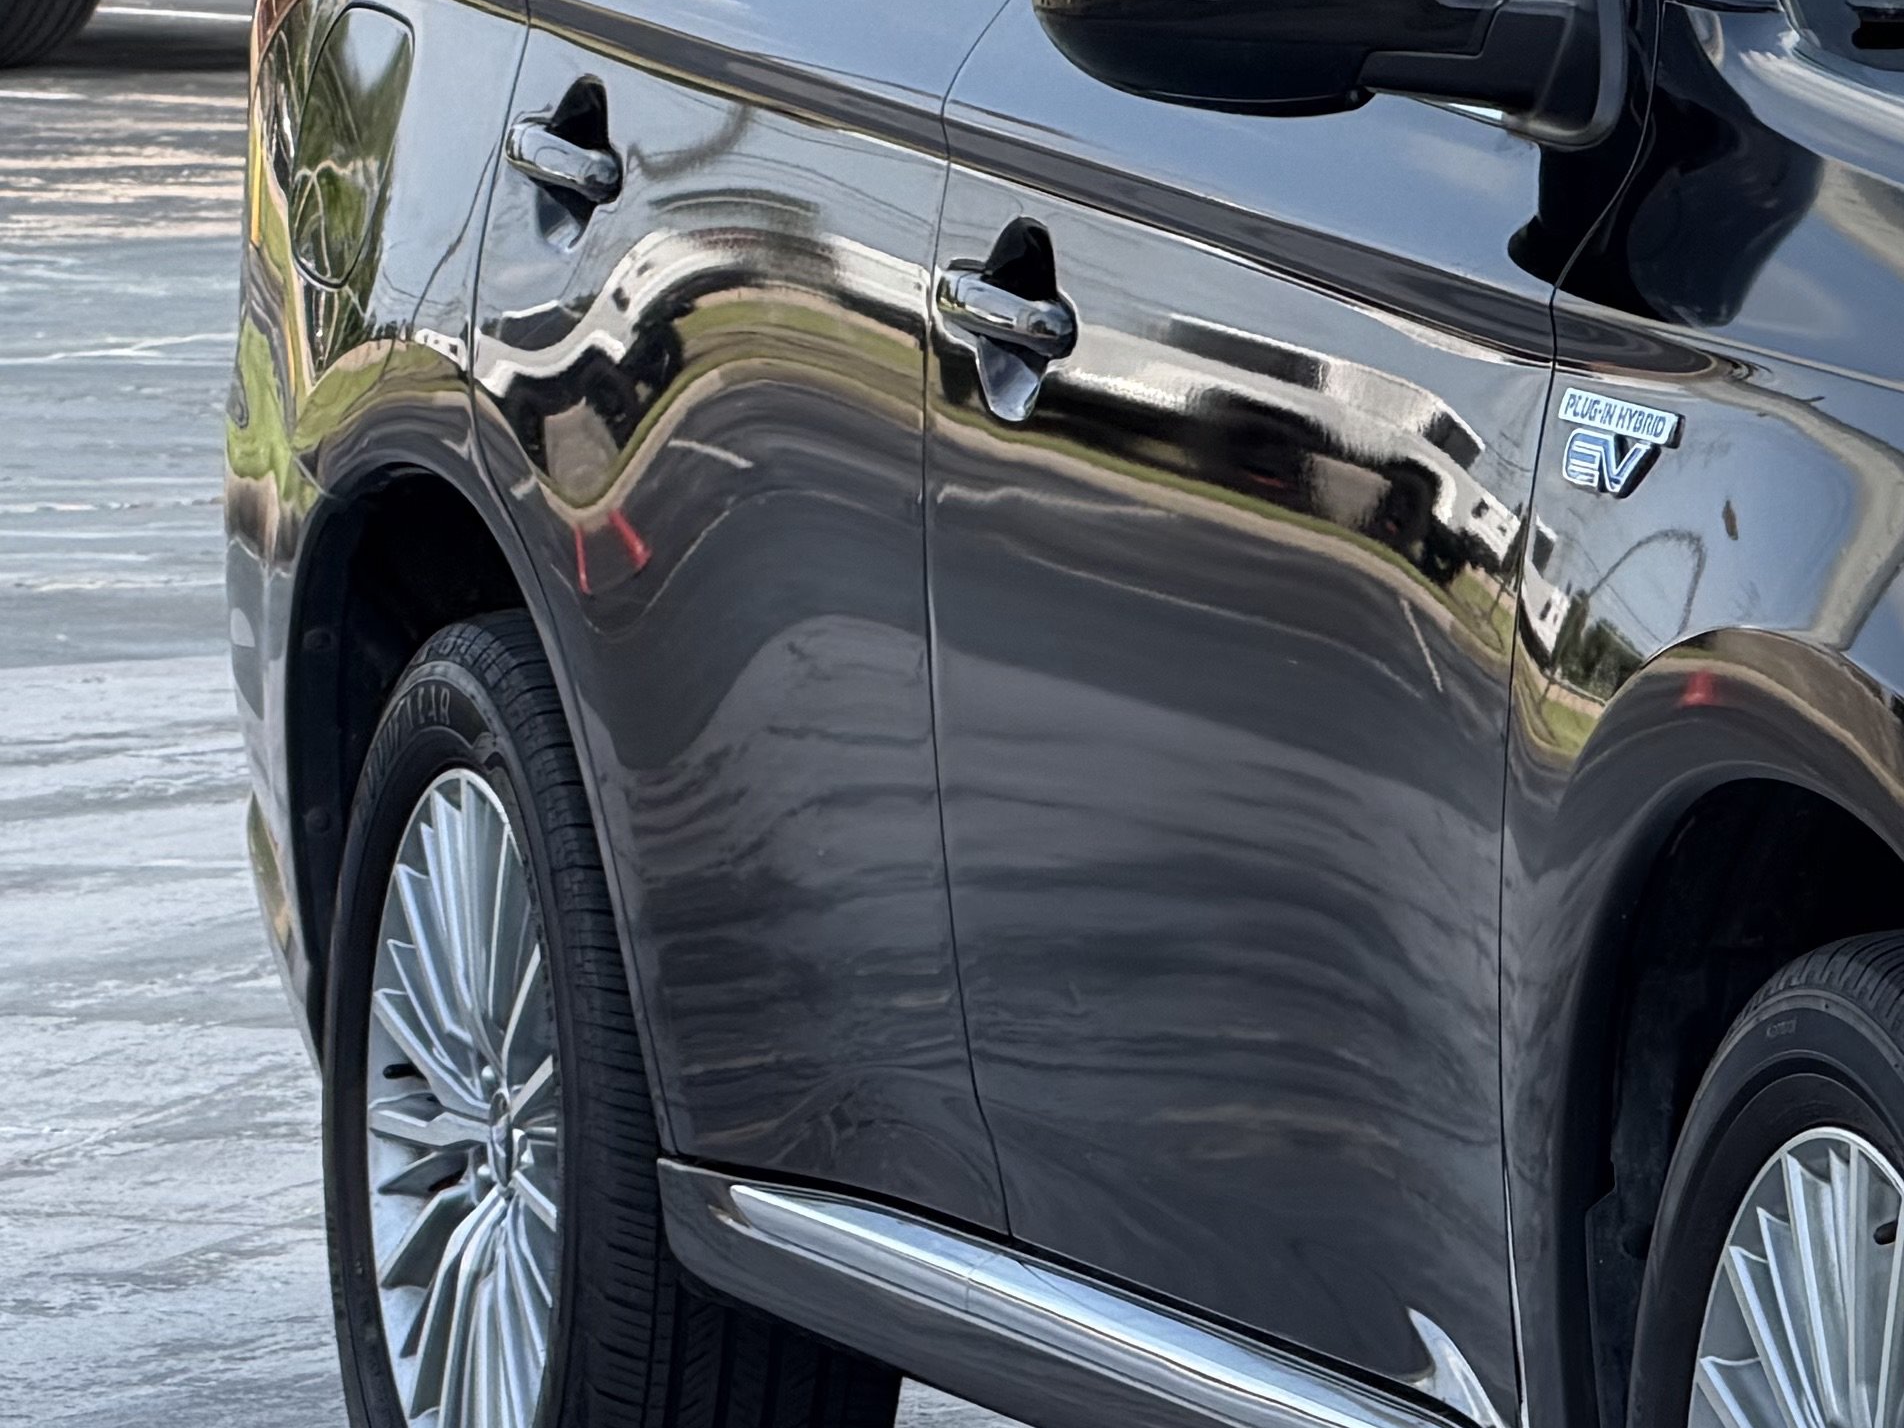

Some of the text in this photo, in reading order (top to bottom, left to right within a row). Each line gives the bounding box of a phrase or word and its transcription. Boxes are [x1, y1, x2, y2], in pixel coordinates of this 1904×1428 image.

[1564, 393, 1667, 438] PLUG-IN HYBRID
[1562, 427, 1653, 493] EV
